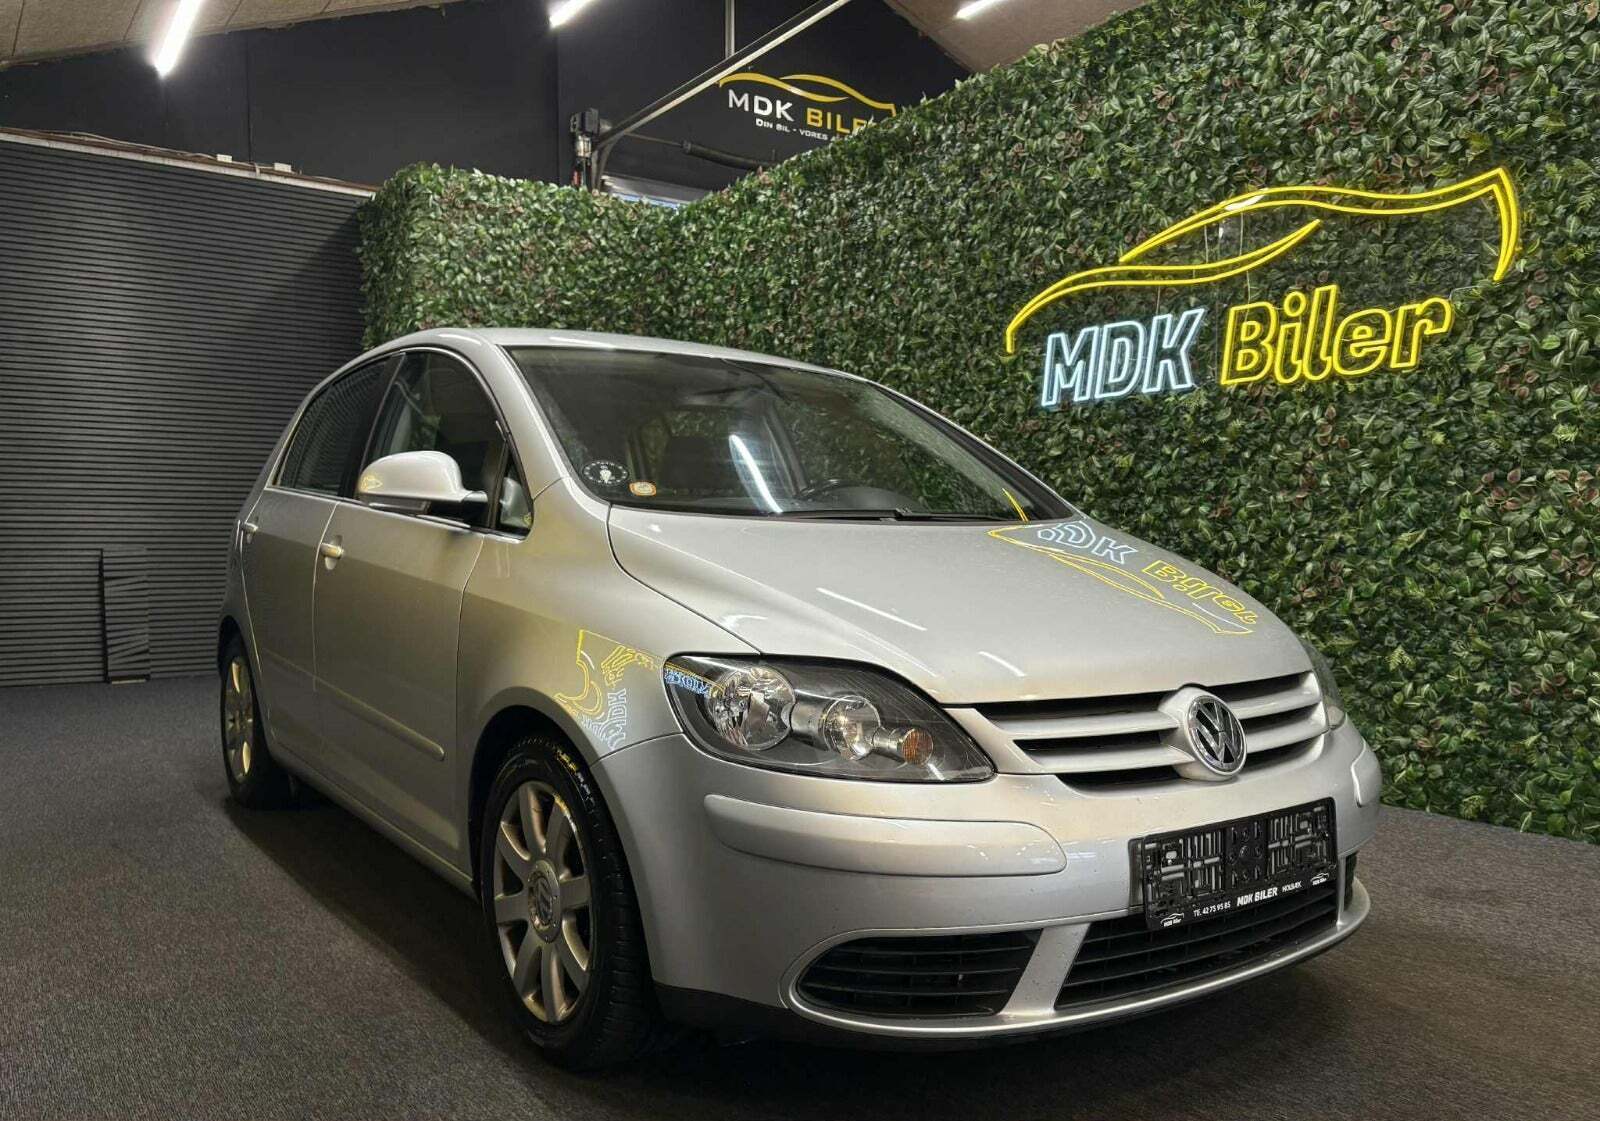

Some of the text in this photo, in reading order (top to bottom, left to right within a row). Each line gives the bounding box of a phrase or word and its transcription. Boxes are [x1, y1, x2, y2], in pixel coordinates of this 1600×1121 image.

[728, 88, 795, 122] MDK
[1041, 284, 1453, 408] MDK Biler
[1236, 893, 1254, 907] MDK
[1254, 886, 1278, 902] BILER
